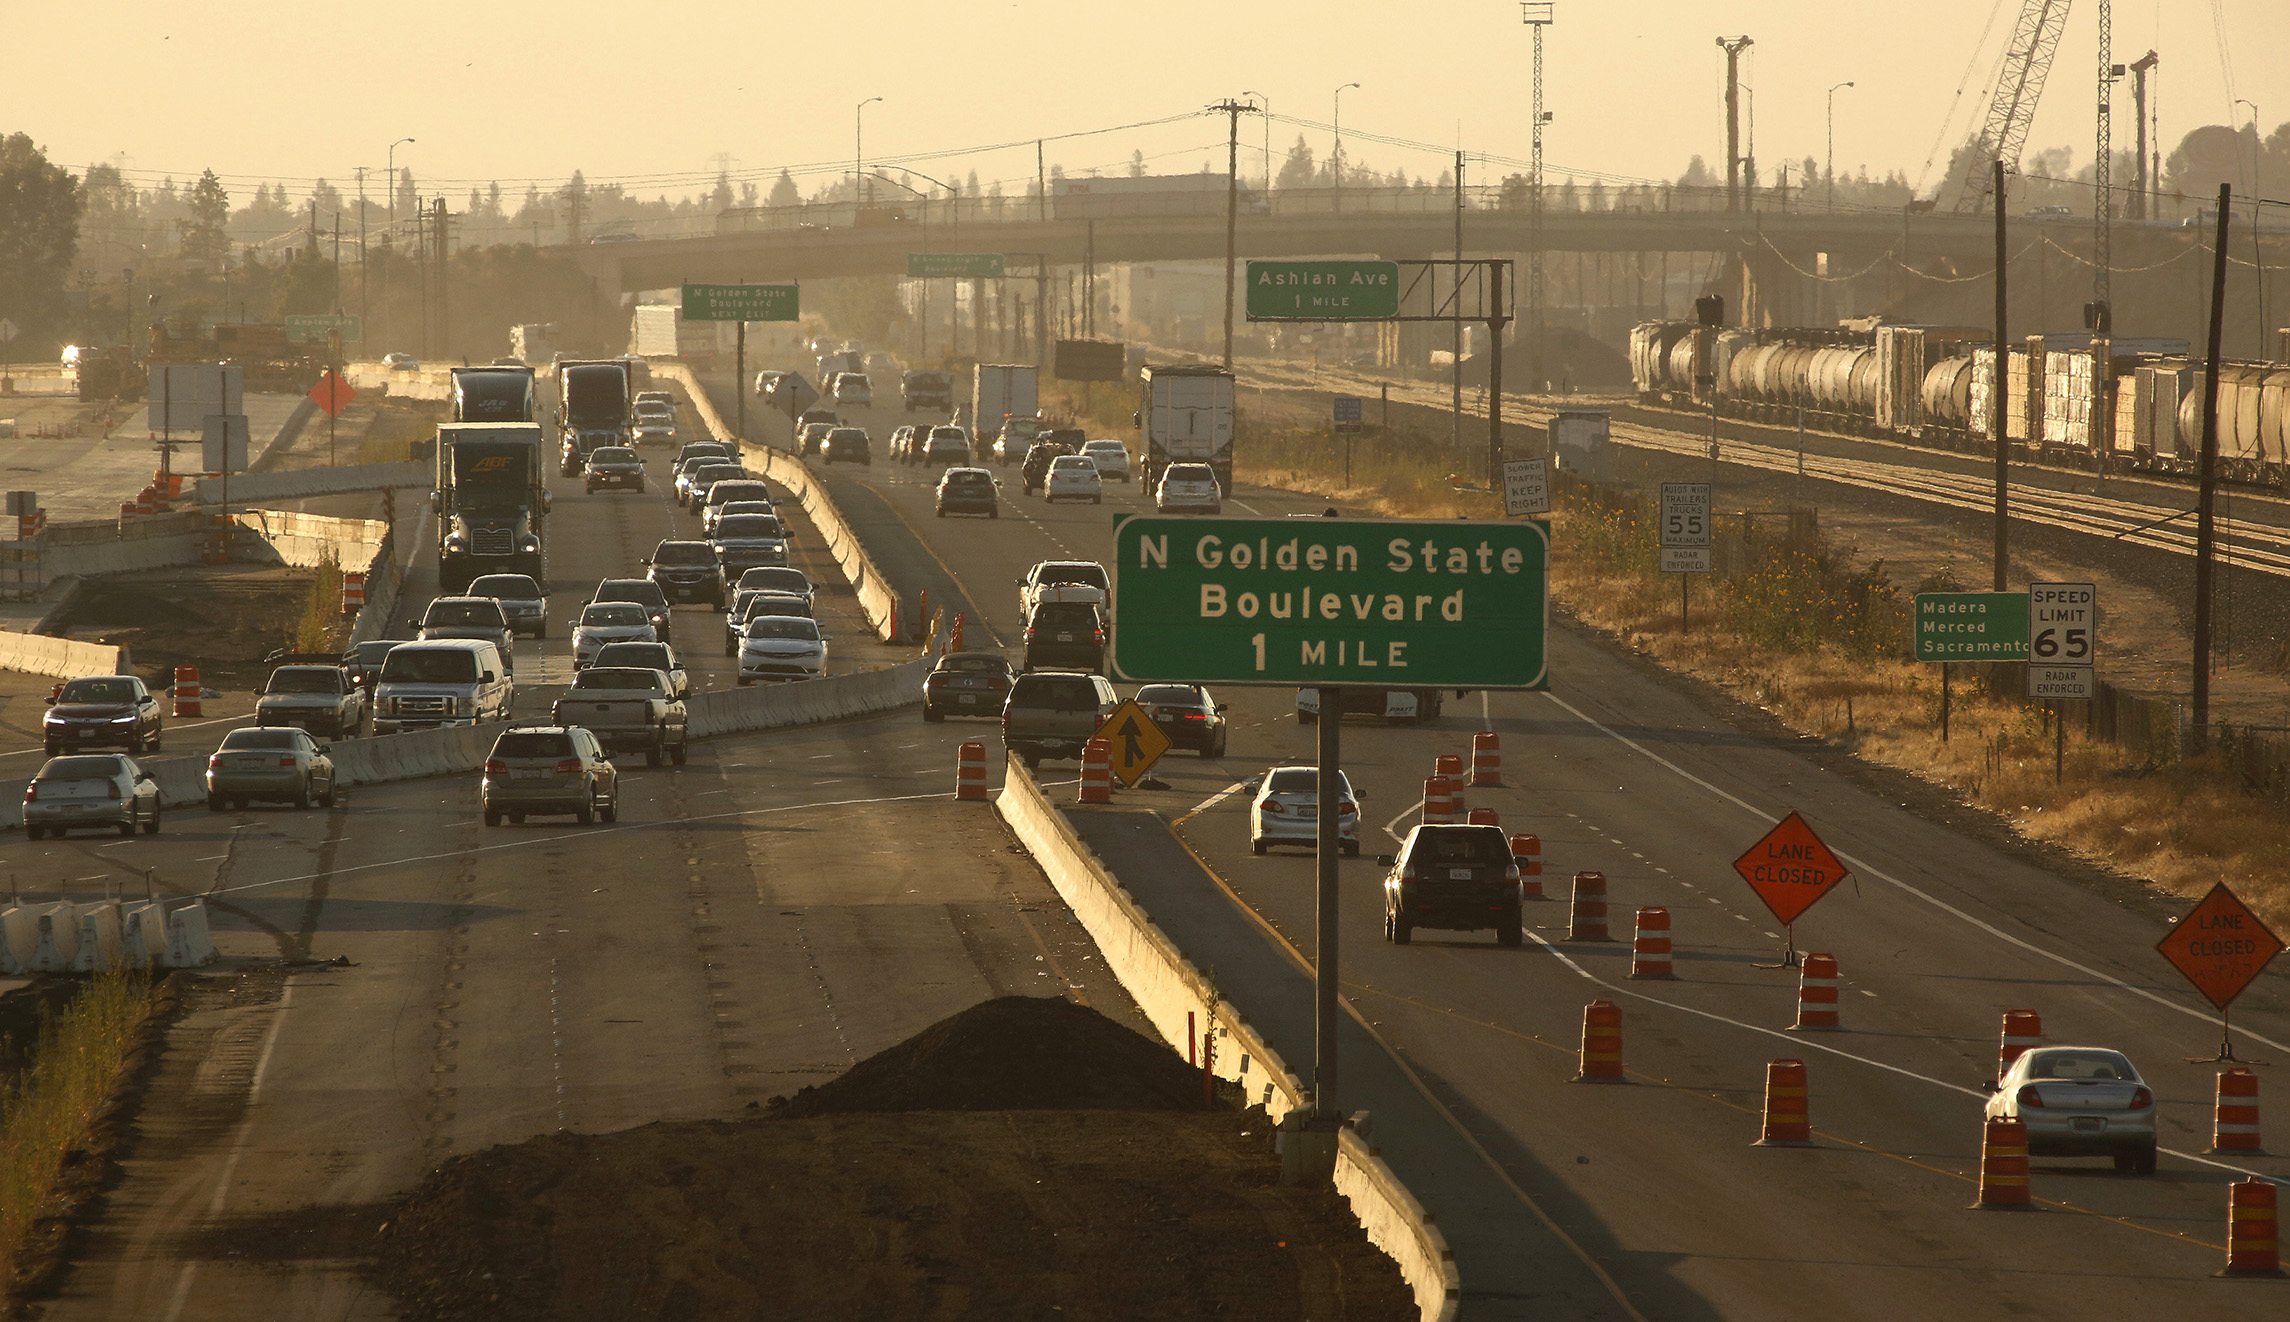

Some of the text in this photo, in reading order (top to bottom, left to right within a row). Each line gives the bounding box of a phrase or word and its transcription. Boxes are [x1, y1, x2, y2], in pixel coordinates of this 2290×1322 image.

[1258, 271, 1388, 286] Ashlan Ave
[709, 289, 747, 297] Golden
[710, 299, 771, 307] Boulevard
[1295, 294, 1350, 309] 1 MILE
[476, 457, 513, 467] ABF
[1508, 463, 1541, 472] SLOWER
[1508, 474, 1543, 482] TRAFFIC
[1512, 486, 1541, 496] KEEP
[1664, 486, 1708, 494] AUTOS WITH
[1511, 498, 1544, 509] RIGHT
[1669, 515, 1702, 534] 55
[1140, 535, 1524, 574] N Golden State
[1667, 561, 1704, 569] ENFORCED
[2034, 591, 2090, 603] SPEED
[1200, 585, 1464, 621] Boulevard
[1923, 602, 1986, 613] Madera
[2040, 609, 2085, 622] LIMIT
[1923, 621, 1985, 632] Merced
[2034, 628, 2088, 658] 65
[1252, 634, 1408, 671] 1 MILE
[2045, 672, 2077, 681] RADAR
[2037, 684, 2085, 694] ENFORCED
[1768, 843, 1815, 860] LANE
[1754, 866, 1825, 885] CLOSED
[2199, 914, 2244, 930] LANE
[2189, 939, 2256, 956] CLOSED
